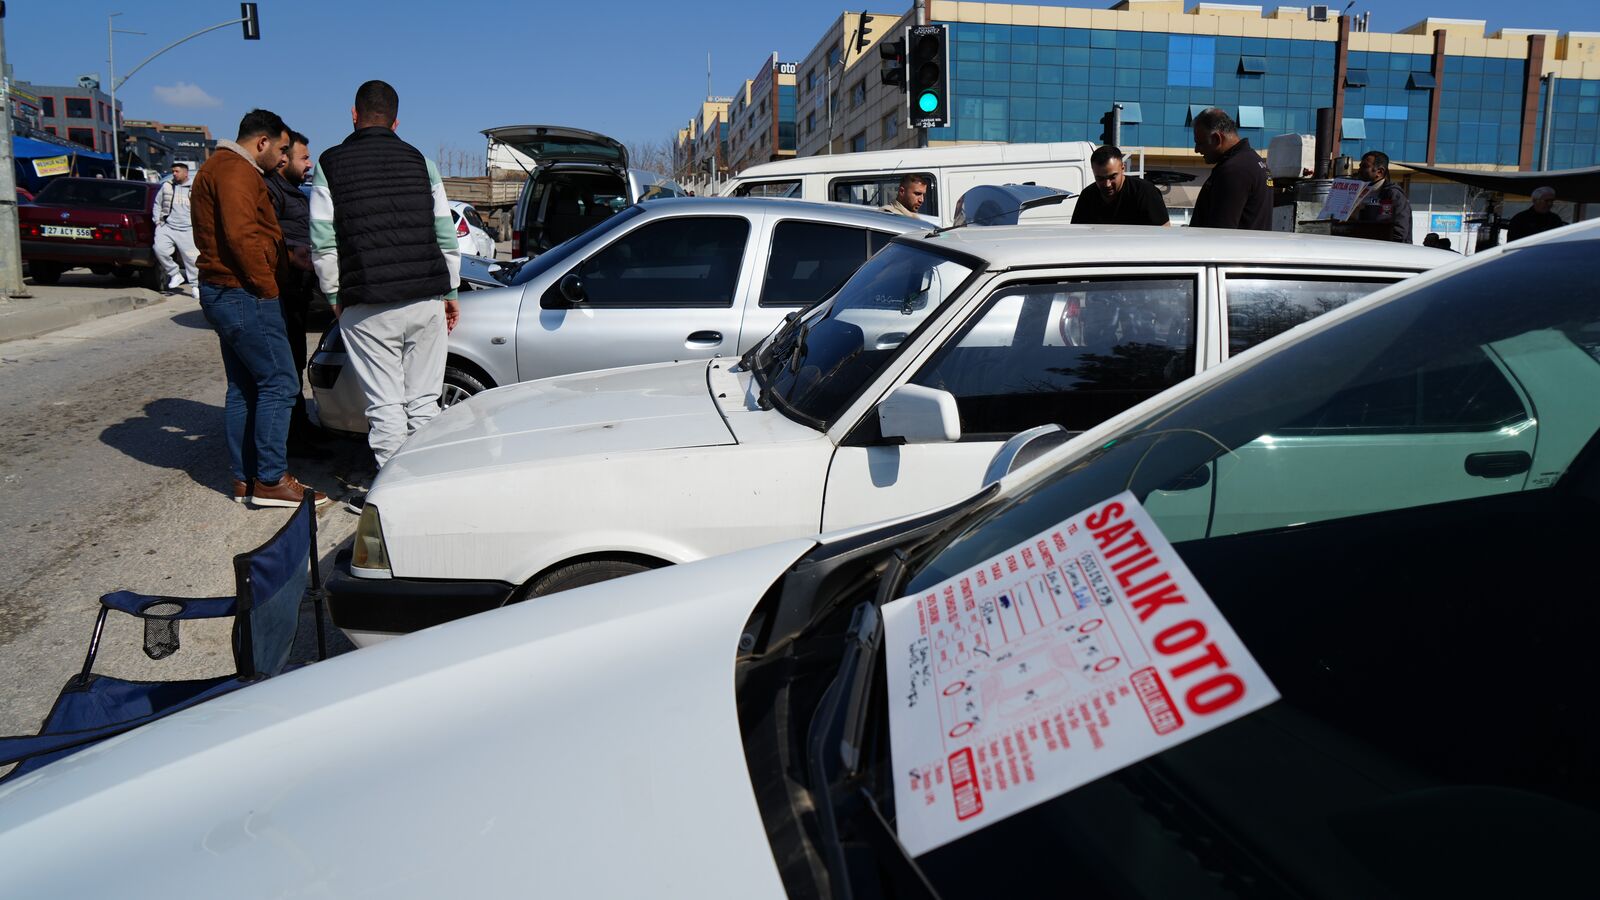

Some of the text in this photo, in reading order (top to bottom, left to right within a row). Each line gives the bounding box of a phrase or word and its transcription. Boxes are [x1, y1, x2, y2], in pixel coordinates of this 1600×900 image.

[48, 226, 90, 237] 27 ACY 556
[1067, 522, 1078, 535] TEL
[1084, 501, 1188, 623] SATILIK
[1152, 618, 1246, 716] OTO
